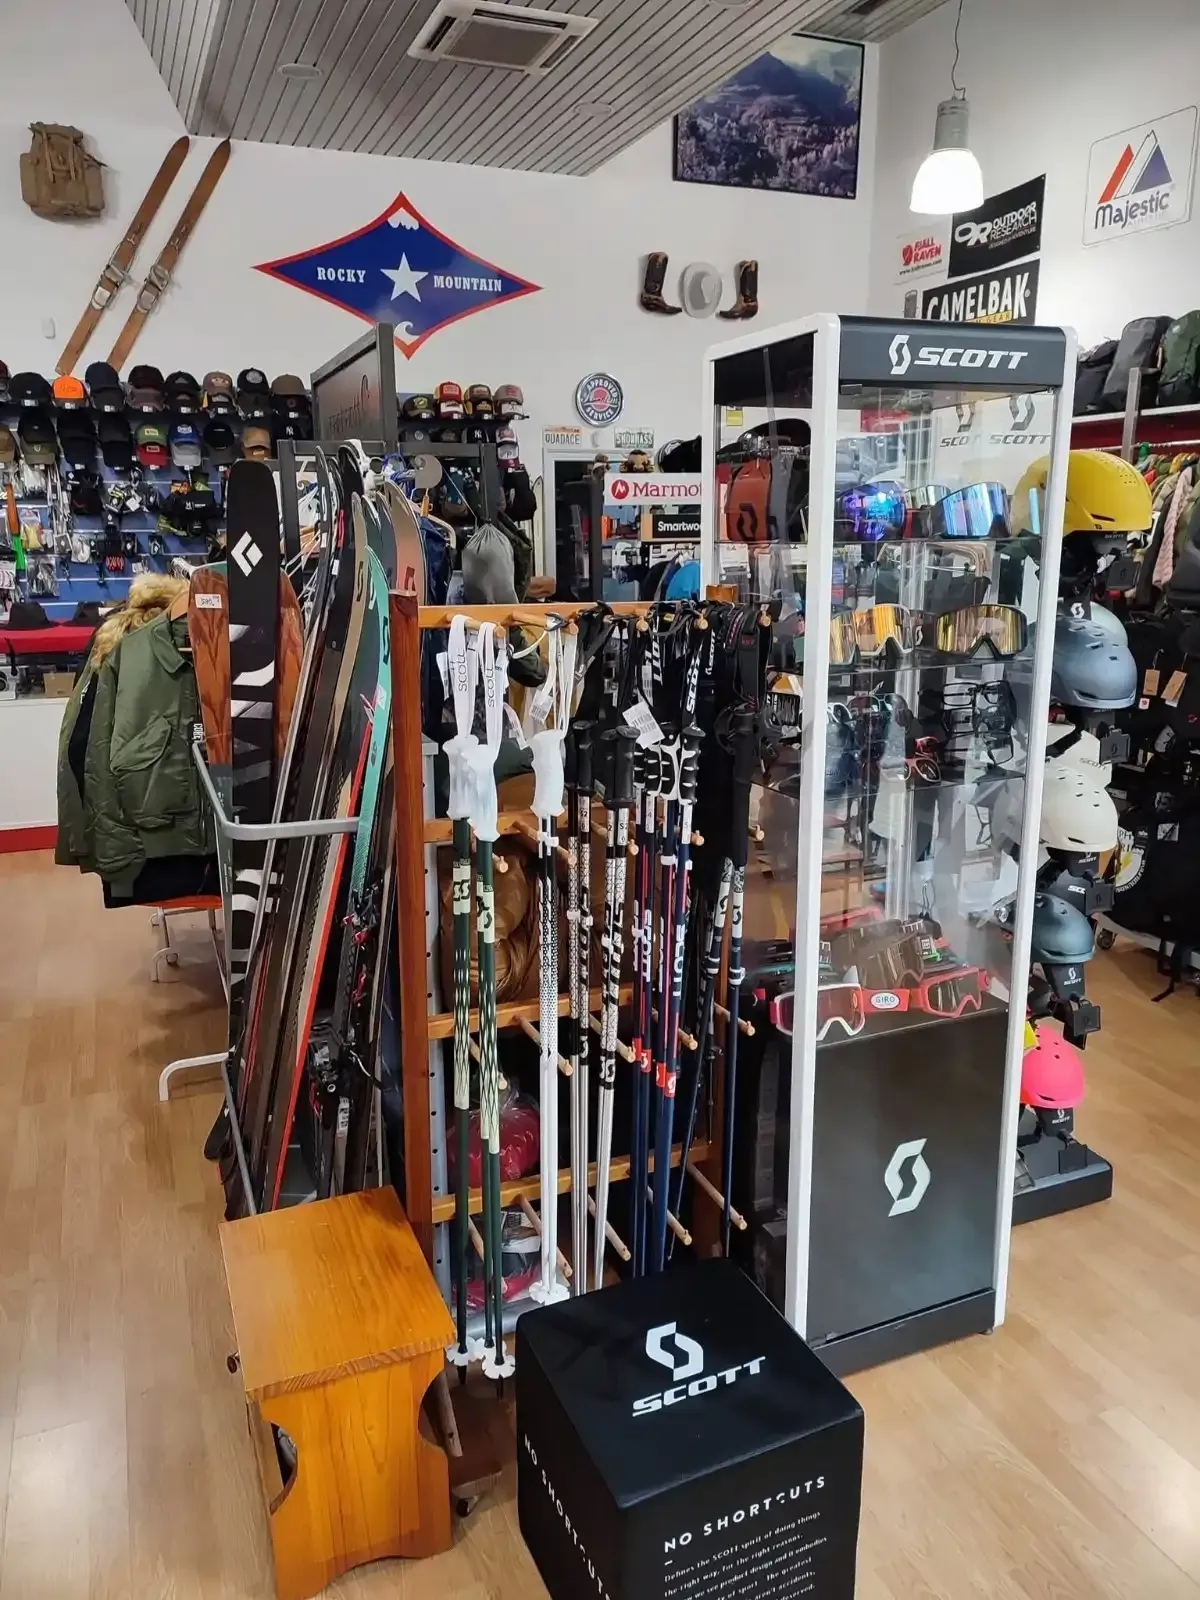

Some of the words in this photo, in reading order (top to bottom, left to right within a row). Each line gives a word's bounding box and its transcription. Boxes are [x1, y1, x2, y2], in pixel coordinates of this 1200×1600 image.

[992, 201, 1037, 229] OUTDOOR
[1094, 190, 1170, 230] Majestic
[989, 211, 1037, 241] RESEARCH
[317, 266, 366, 283] ROCKY
[433, 275, 502, 292] MOUNTAIN
[913, 346, 1029, 371] SCOTT
[586, 378, 618, 399] APPROVED
[585, 406, 614, 421] SERVICE
[545, 433, 580, 445] QUADACE
[657, 521, 701, 532] Smartwo
[672, 923, 686, 999] SCOTT
[875, 996, 896, 1004] GIRO
[632, 1355, 766, 1418] SCOTT
[524, 1433, 538, 1466] NO
[664, 1532, 693, 1554] NO
[703, 1475, 826, 1537] SHORTCUTS
[664, 1565, 695, 1583] Defines
[697, 1558, 711, 1569] the
[741, 1535, 761, 1550] spirit
[764, 1530, 773, 1540] of
[774, 1521, 796, 1535] doing
[797, 1511, 821, 1525] things
[664, 1588, 679, 1598] the
[680, 1577, 701, 1591] right
[702, 1570, 720, 1581] way,
[722, 1563, 734, 1573] for
[736, 1556, 750, 1567] the
[751, 1546, 771, 1559] right
[694, 1590, 705, 1599] we
[706, 1584, 719, 1594] see
[720, 1569, 748, 1590] product
[750, 1560, 773, 1575] design
[774, 1552, 788, 1564] and
[795, 1536, 828, 1555] embodies
[781, 1556, 812, 1576] greatest
